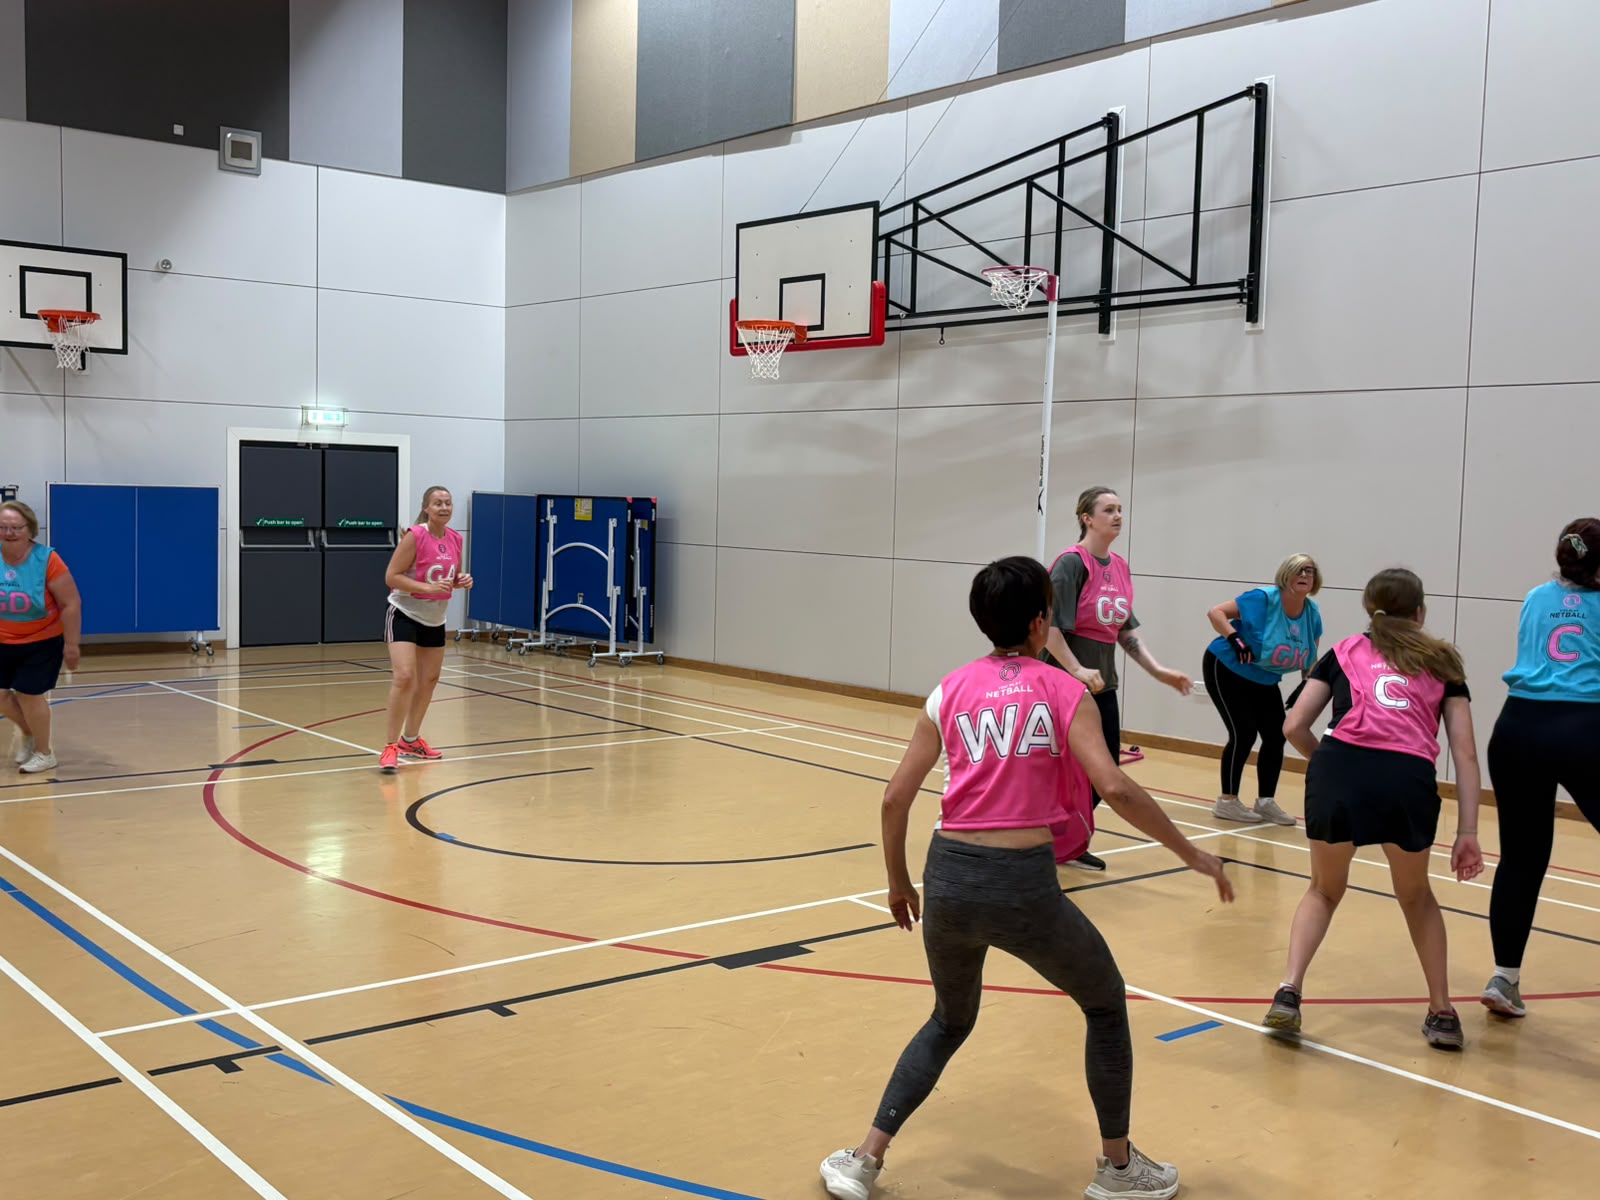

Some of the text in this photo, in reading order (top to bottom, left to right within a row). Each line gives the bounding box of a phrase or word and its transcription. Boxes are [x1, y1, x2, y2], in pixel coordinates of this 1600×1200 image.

[1096, 595, 1129, 625] GS
[1546, 622, 1584, 662] C
[985, 684, 1034, 699] NETBALL
[1374, 674, 1409, 709] C
[955, 702, 1061, 764] WA
